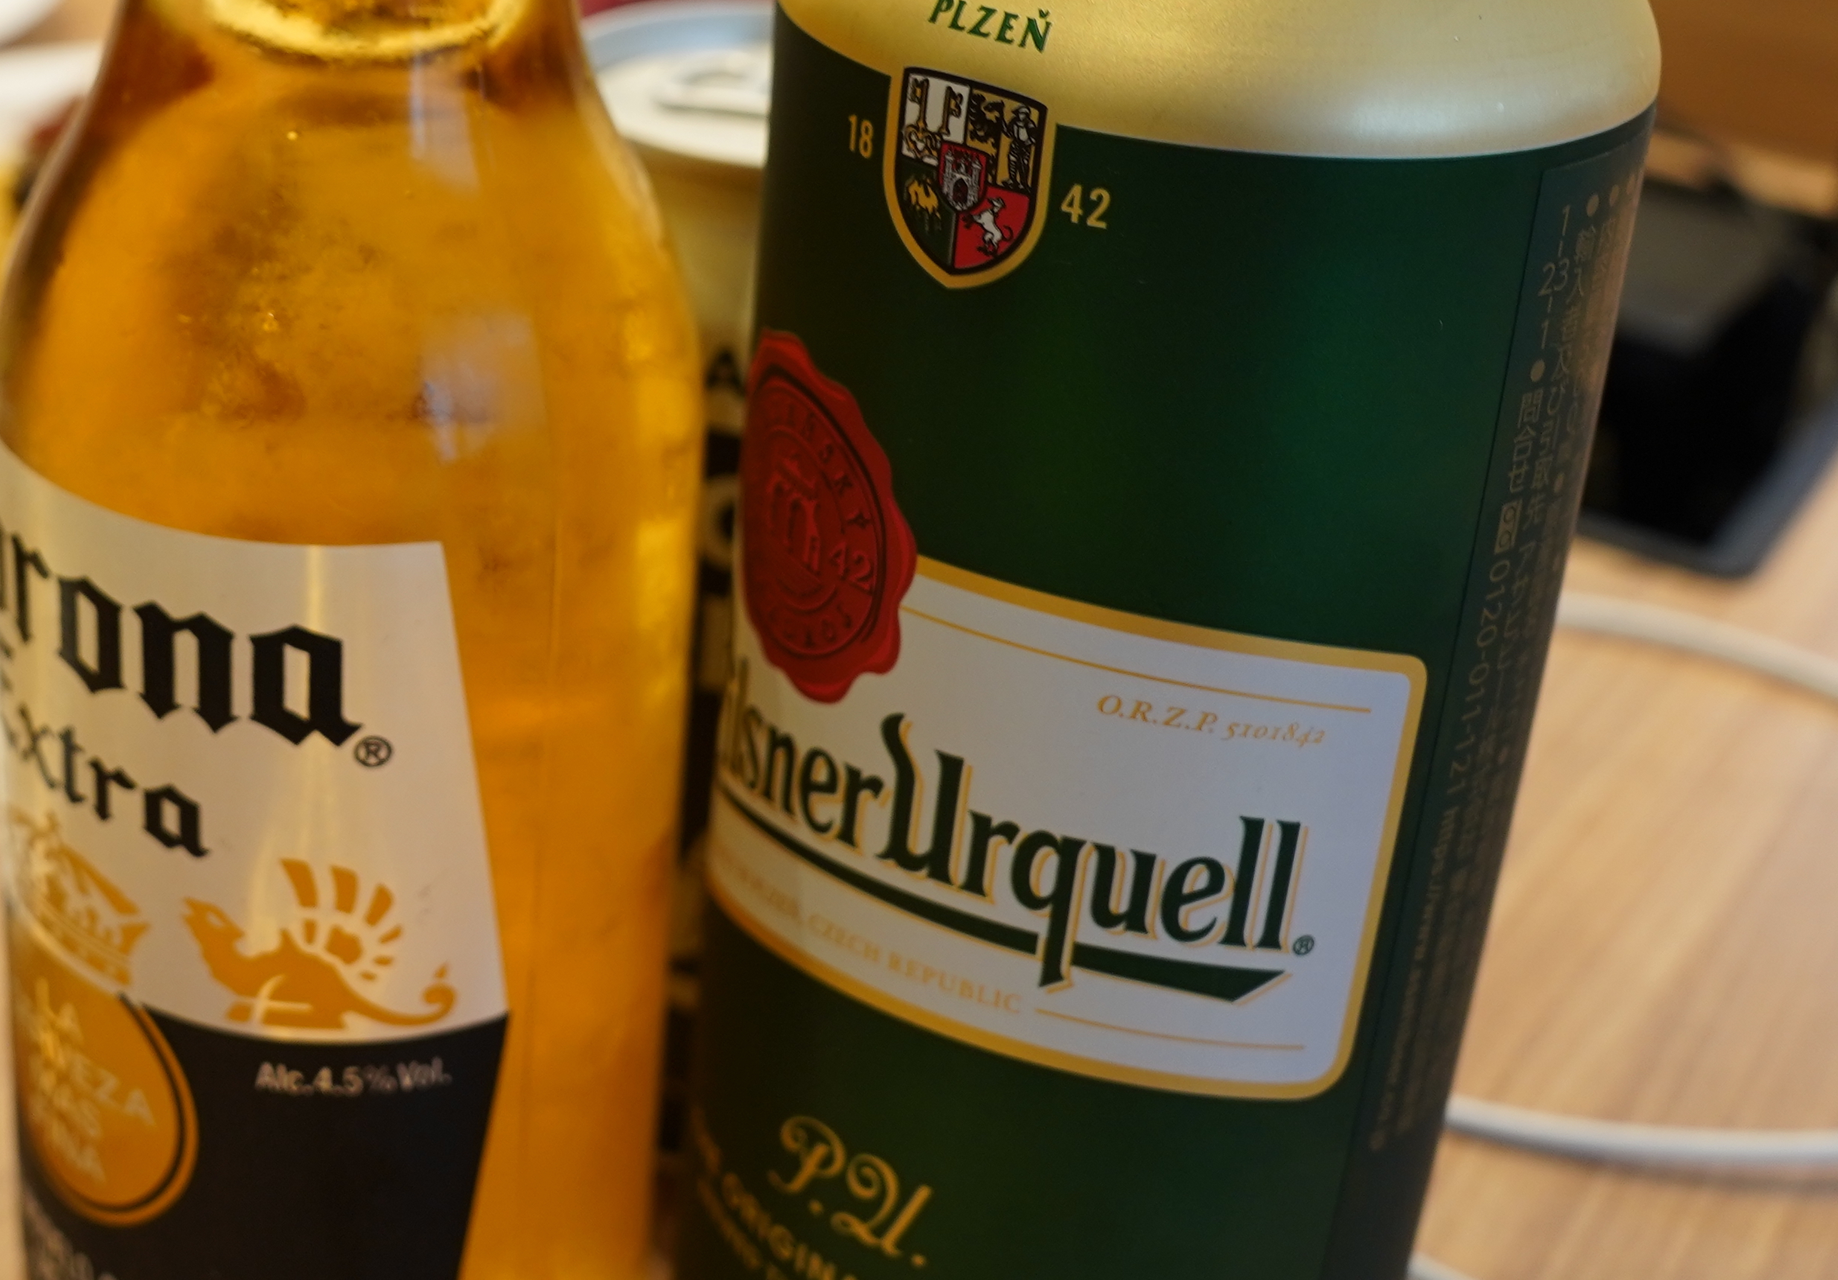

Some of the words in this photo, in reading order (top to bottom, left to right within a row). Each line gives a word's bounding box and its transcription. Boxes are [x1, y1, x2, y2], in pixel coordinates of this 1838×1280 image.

[848, 114, 874, 159] 18
[1060, 183, 1112, 230] 42
[0, 635, 210, 859] xtra
[875, 712, 1302, 988] Urquell
[887, 952, 1022, 1014] REPUBLIC
